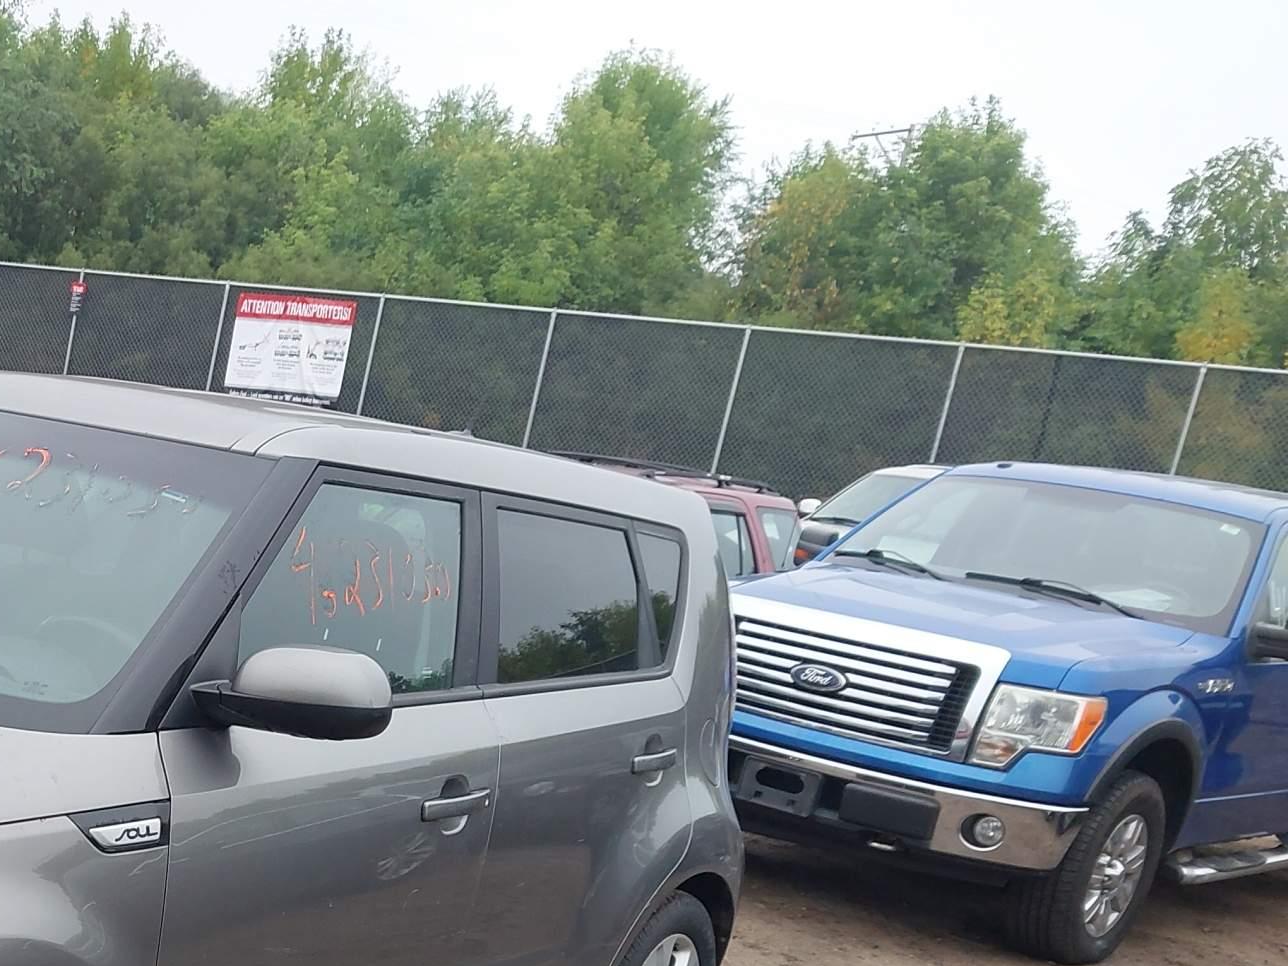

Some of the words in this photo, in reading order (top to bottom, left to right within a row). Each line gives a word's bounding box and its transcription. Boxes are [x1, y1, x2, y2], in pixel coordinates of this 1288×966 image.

[240, 299, 285, 314] ATTENTION
[285, 302, 351, 321] TRANSPORTERS!
[800, 667, 833, 686] Ford
